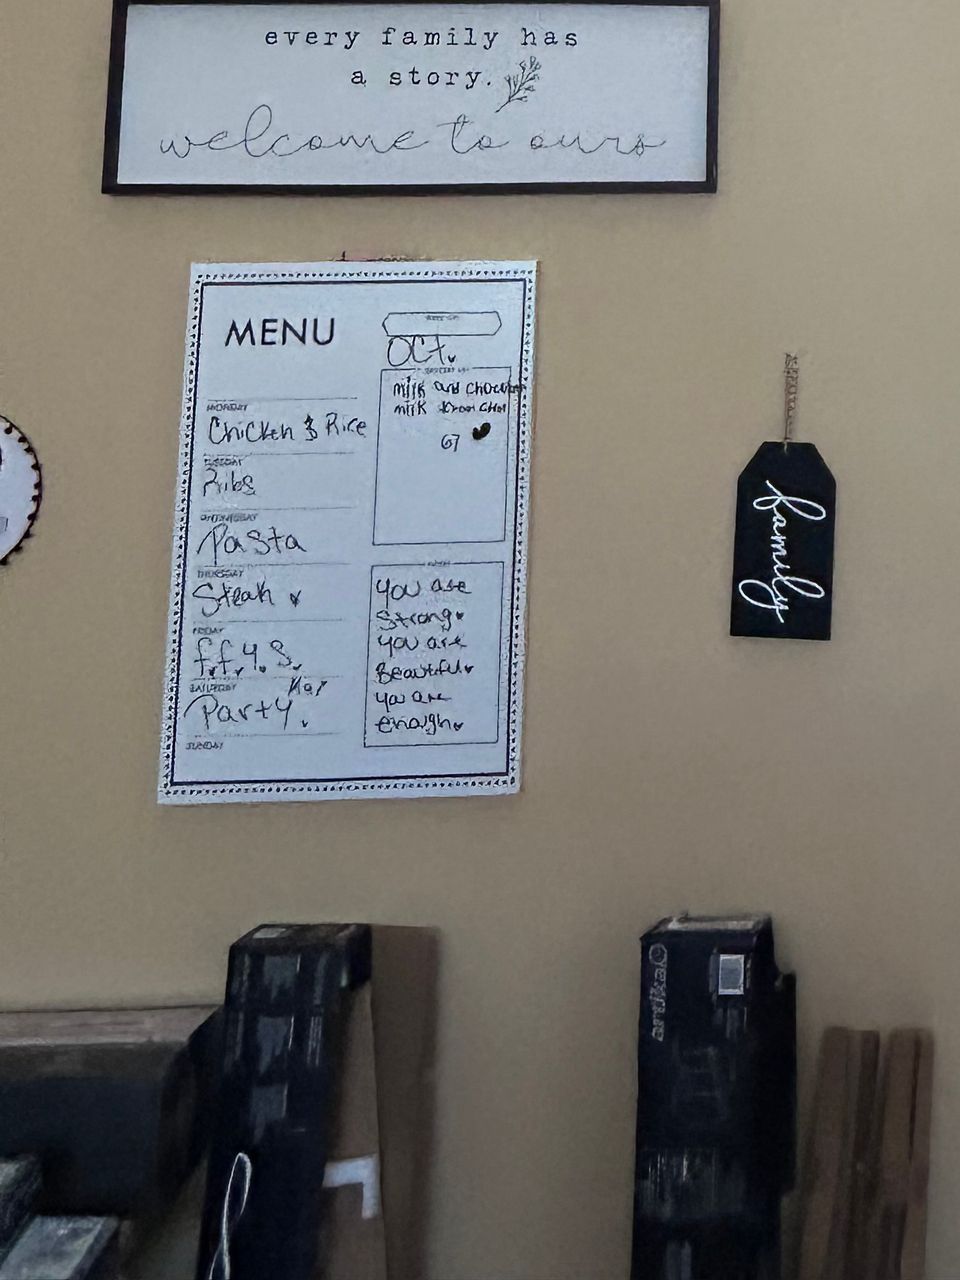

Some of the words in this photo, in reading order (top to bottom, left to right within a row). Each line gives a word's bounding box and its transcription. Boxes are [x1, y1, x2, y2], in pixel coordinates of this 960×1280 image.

[264, 26, 361, 50] every
[380, 25, 499, 51] family
[521, 24, 580, 48] has
[350, 68, 367, 87] a
[388, 64, 494, 90] story.
[160, 104, 433, 158] welcome
[437, 114, 511, 155] to
[529, 128, 668, 157] ours
[224, 317, 334, 347] MENU
[325, 412, 368, 438] Rice
[196, 522, 307, 566] Pasta
[738, 479, 827, 624] family
[192, 580, 275, 618] Steak
